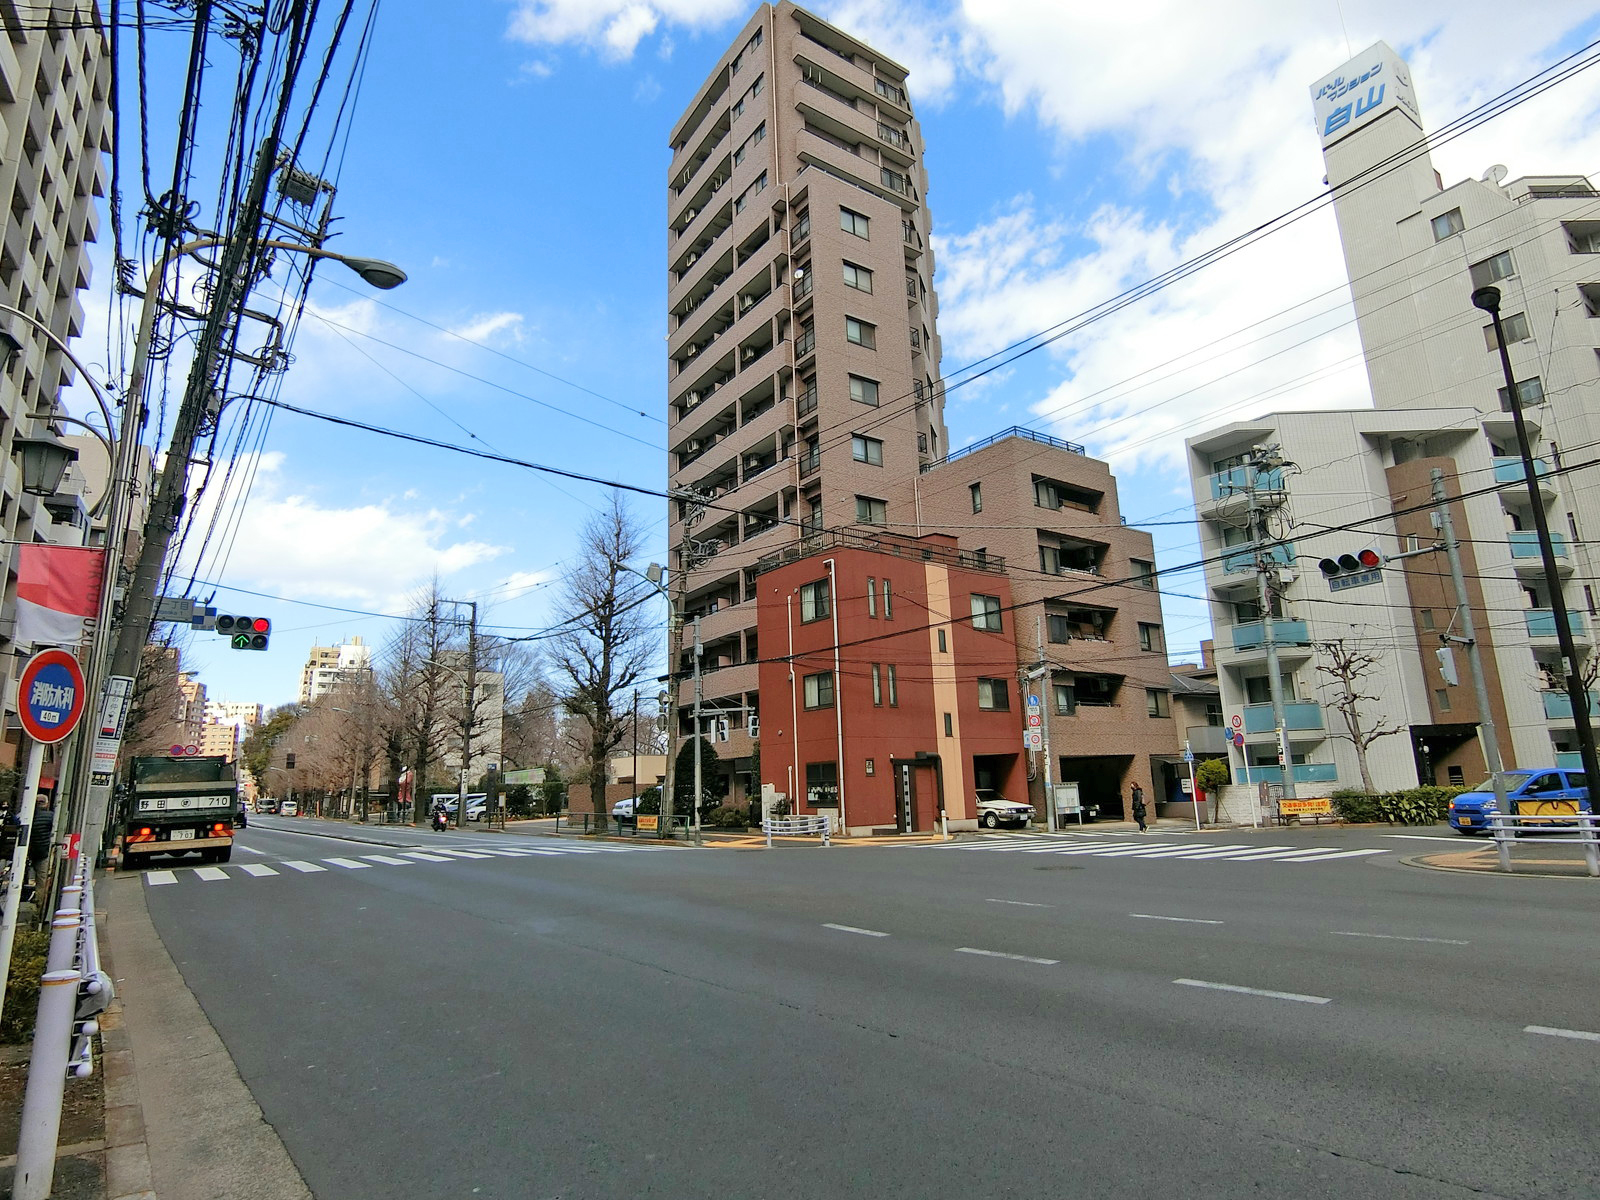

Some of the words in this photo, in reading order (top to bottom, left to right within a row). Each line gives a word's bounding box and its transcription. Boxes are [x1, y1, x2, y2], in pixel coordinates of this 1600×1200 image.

[1327, 62, 1383, 102] マンション
[1324, 83, 1386, 137] 白山
[1332, 571, 1380, 590] 自転車専用
[30, 680, 75, 711] 消防水利
[140, 800, 166, 809] 野田
[208, 797, 228, 806] 710
